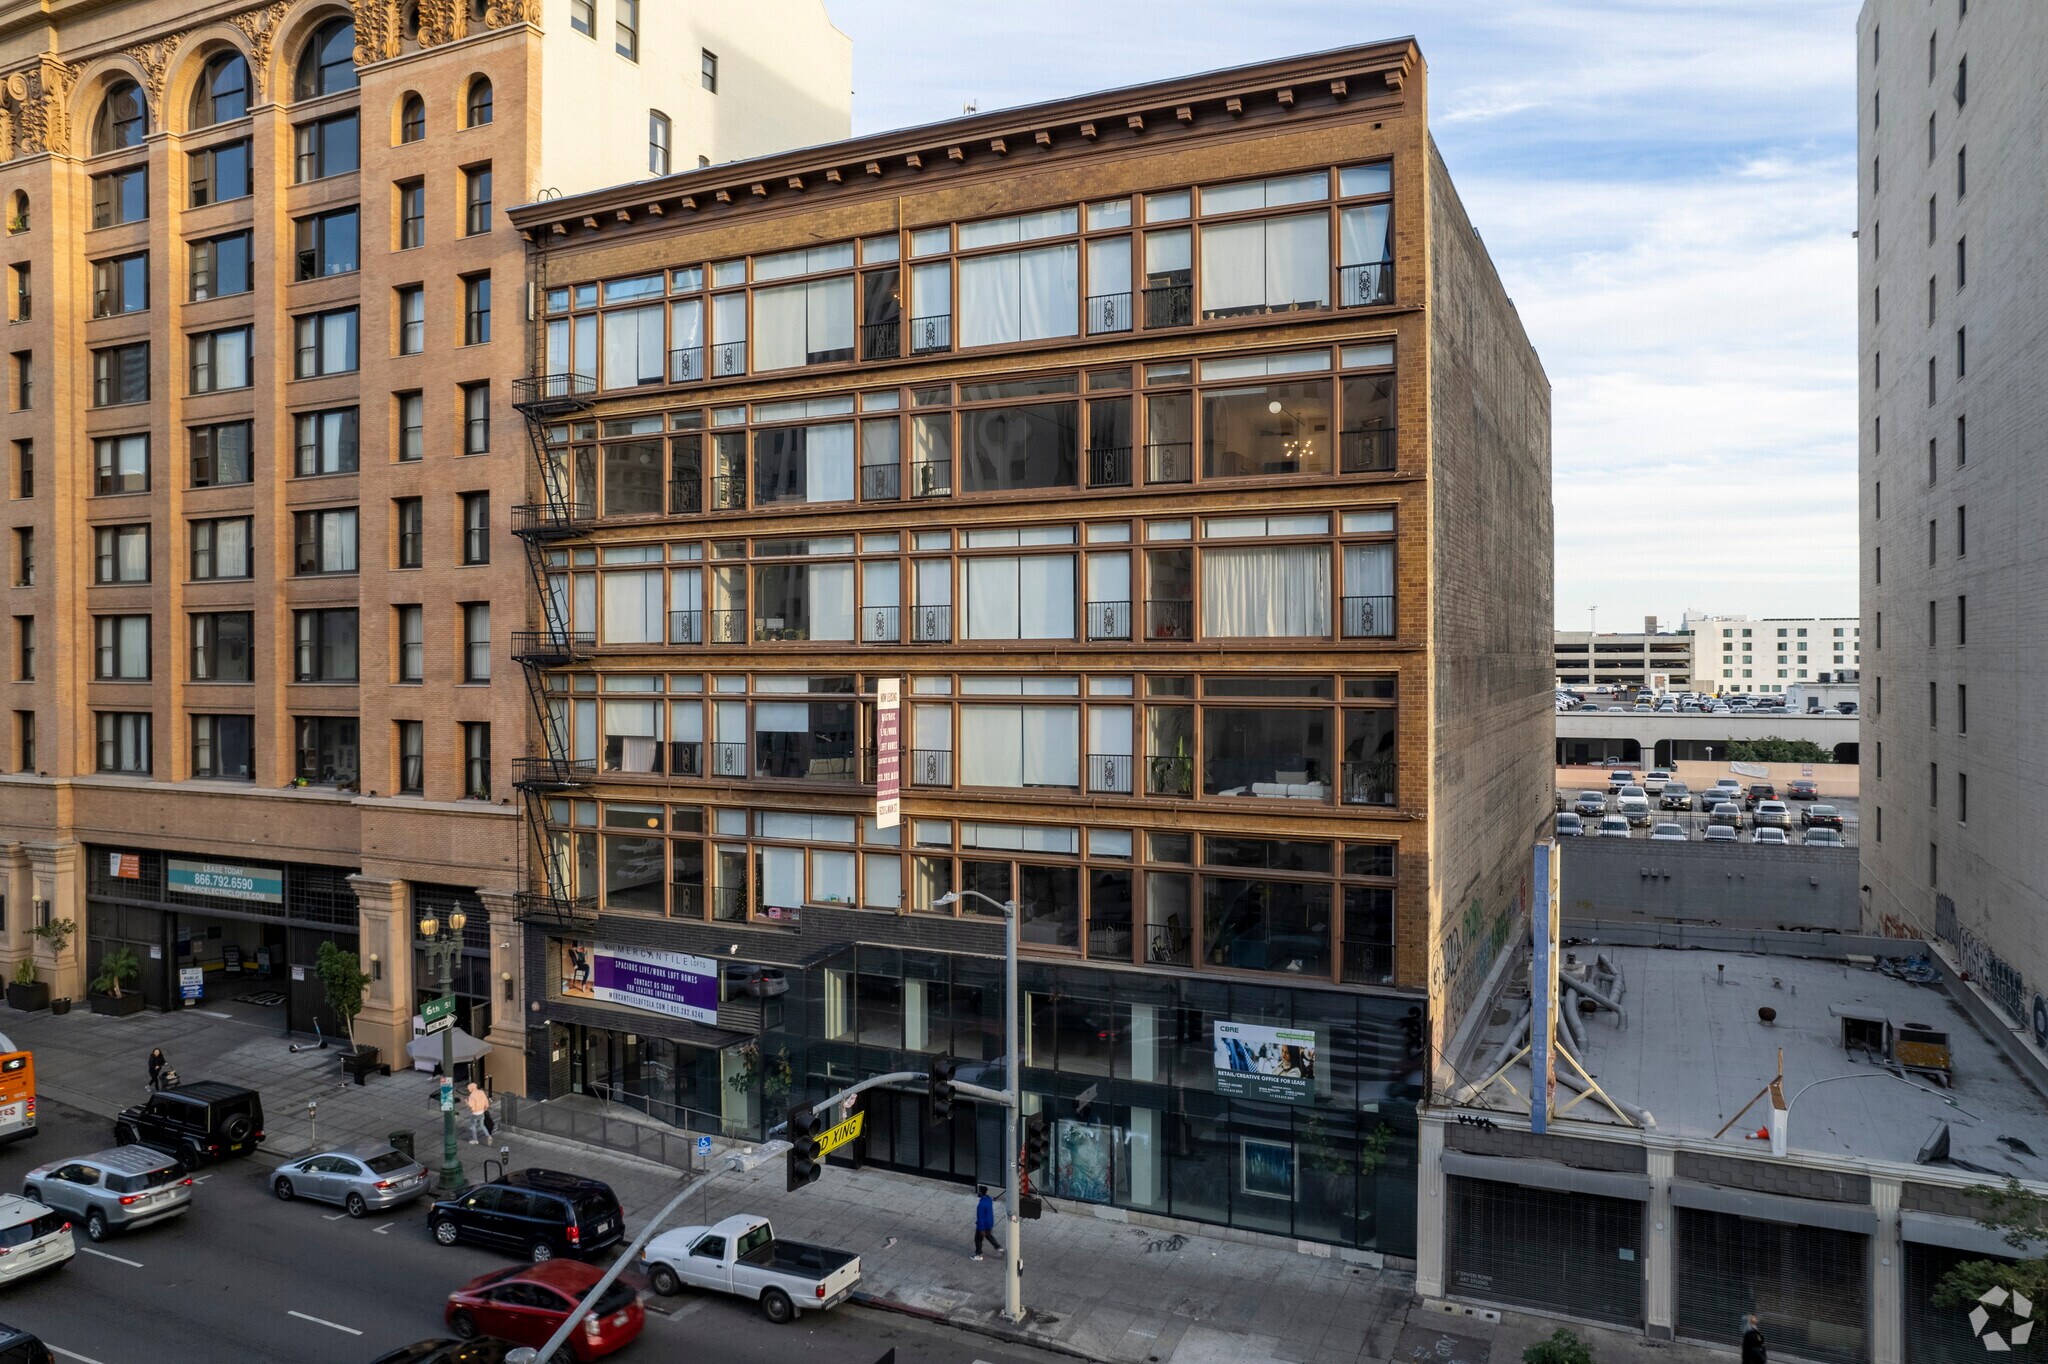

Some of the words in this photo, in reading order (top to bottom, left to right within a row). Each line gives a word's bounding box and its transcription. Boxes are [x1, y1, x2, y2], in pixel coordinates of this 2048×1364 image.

[203, 865, 223, 874] LEASE
[224, 866, 244, 876] TODAY
[194, 873, 253, 891] 866.792.6590
[183, 884, 266, 901] PACIFICELECTRICLOFTS.COM
[617, 945, 688, 966] MERCANTILE
[690, 960, 706, 969] LOFTS
[615, 960, 638, 973] SPACIOUS
[639, 965, 666, 978] LIVE/WORK
[667, 971, 679, 980] LOFT
[681, 973, 698, 984] HOMES
[626, 984, 635, 992] FOR
[635, 986, 654, 997] LEASING
[654, 990, 684, 1003] INFORMATION
[633, 978, 653, 988] CONTACT
[654, 981, 660, 989] US
[661, 983, 675, 993] TODAY
[426, 1005, 440, 1015] 6th
[428, 1022, 438, 1031] ONE
[438, 1019, 447, 1027] WAY
[1220, 1026, 1239, 1034] CBRE
[1218, 1070, 1260, 1081] RETAIL/CREATIVE
[1261, 1075, 1280, 1083] OFFICE
[832, 1119, 856, 1145] XING
